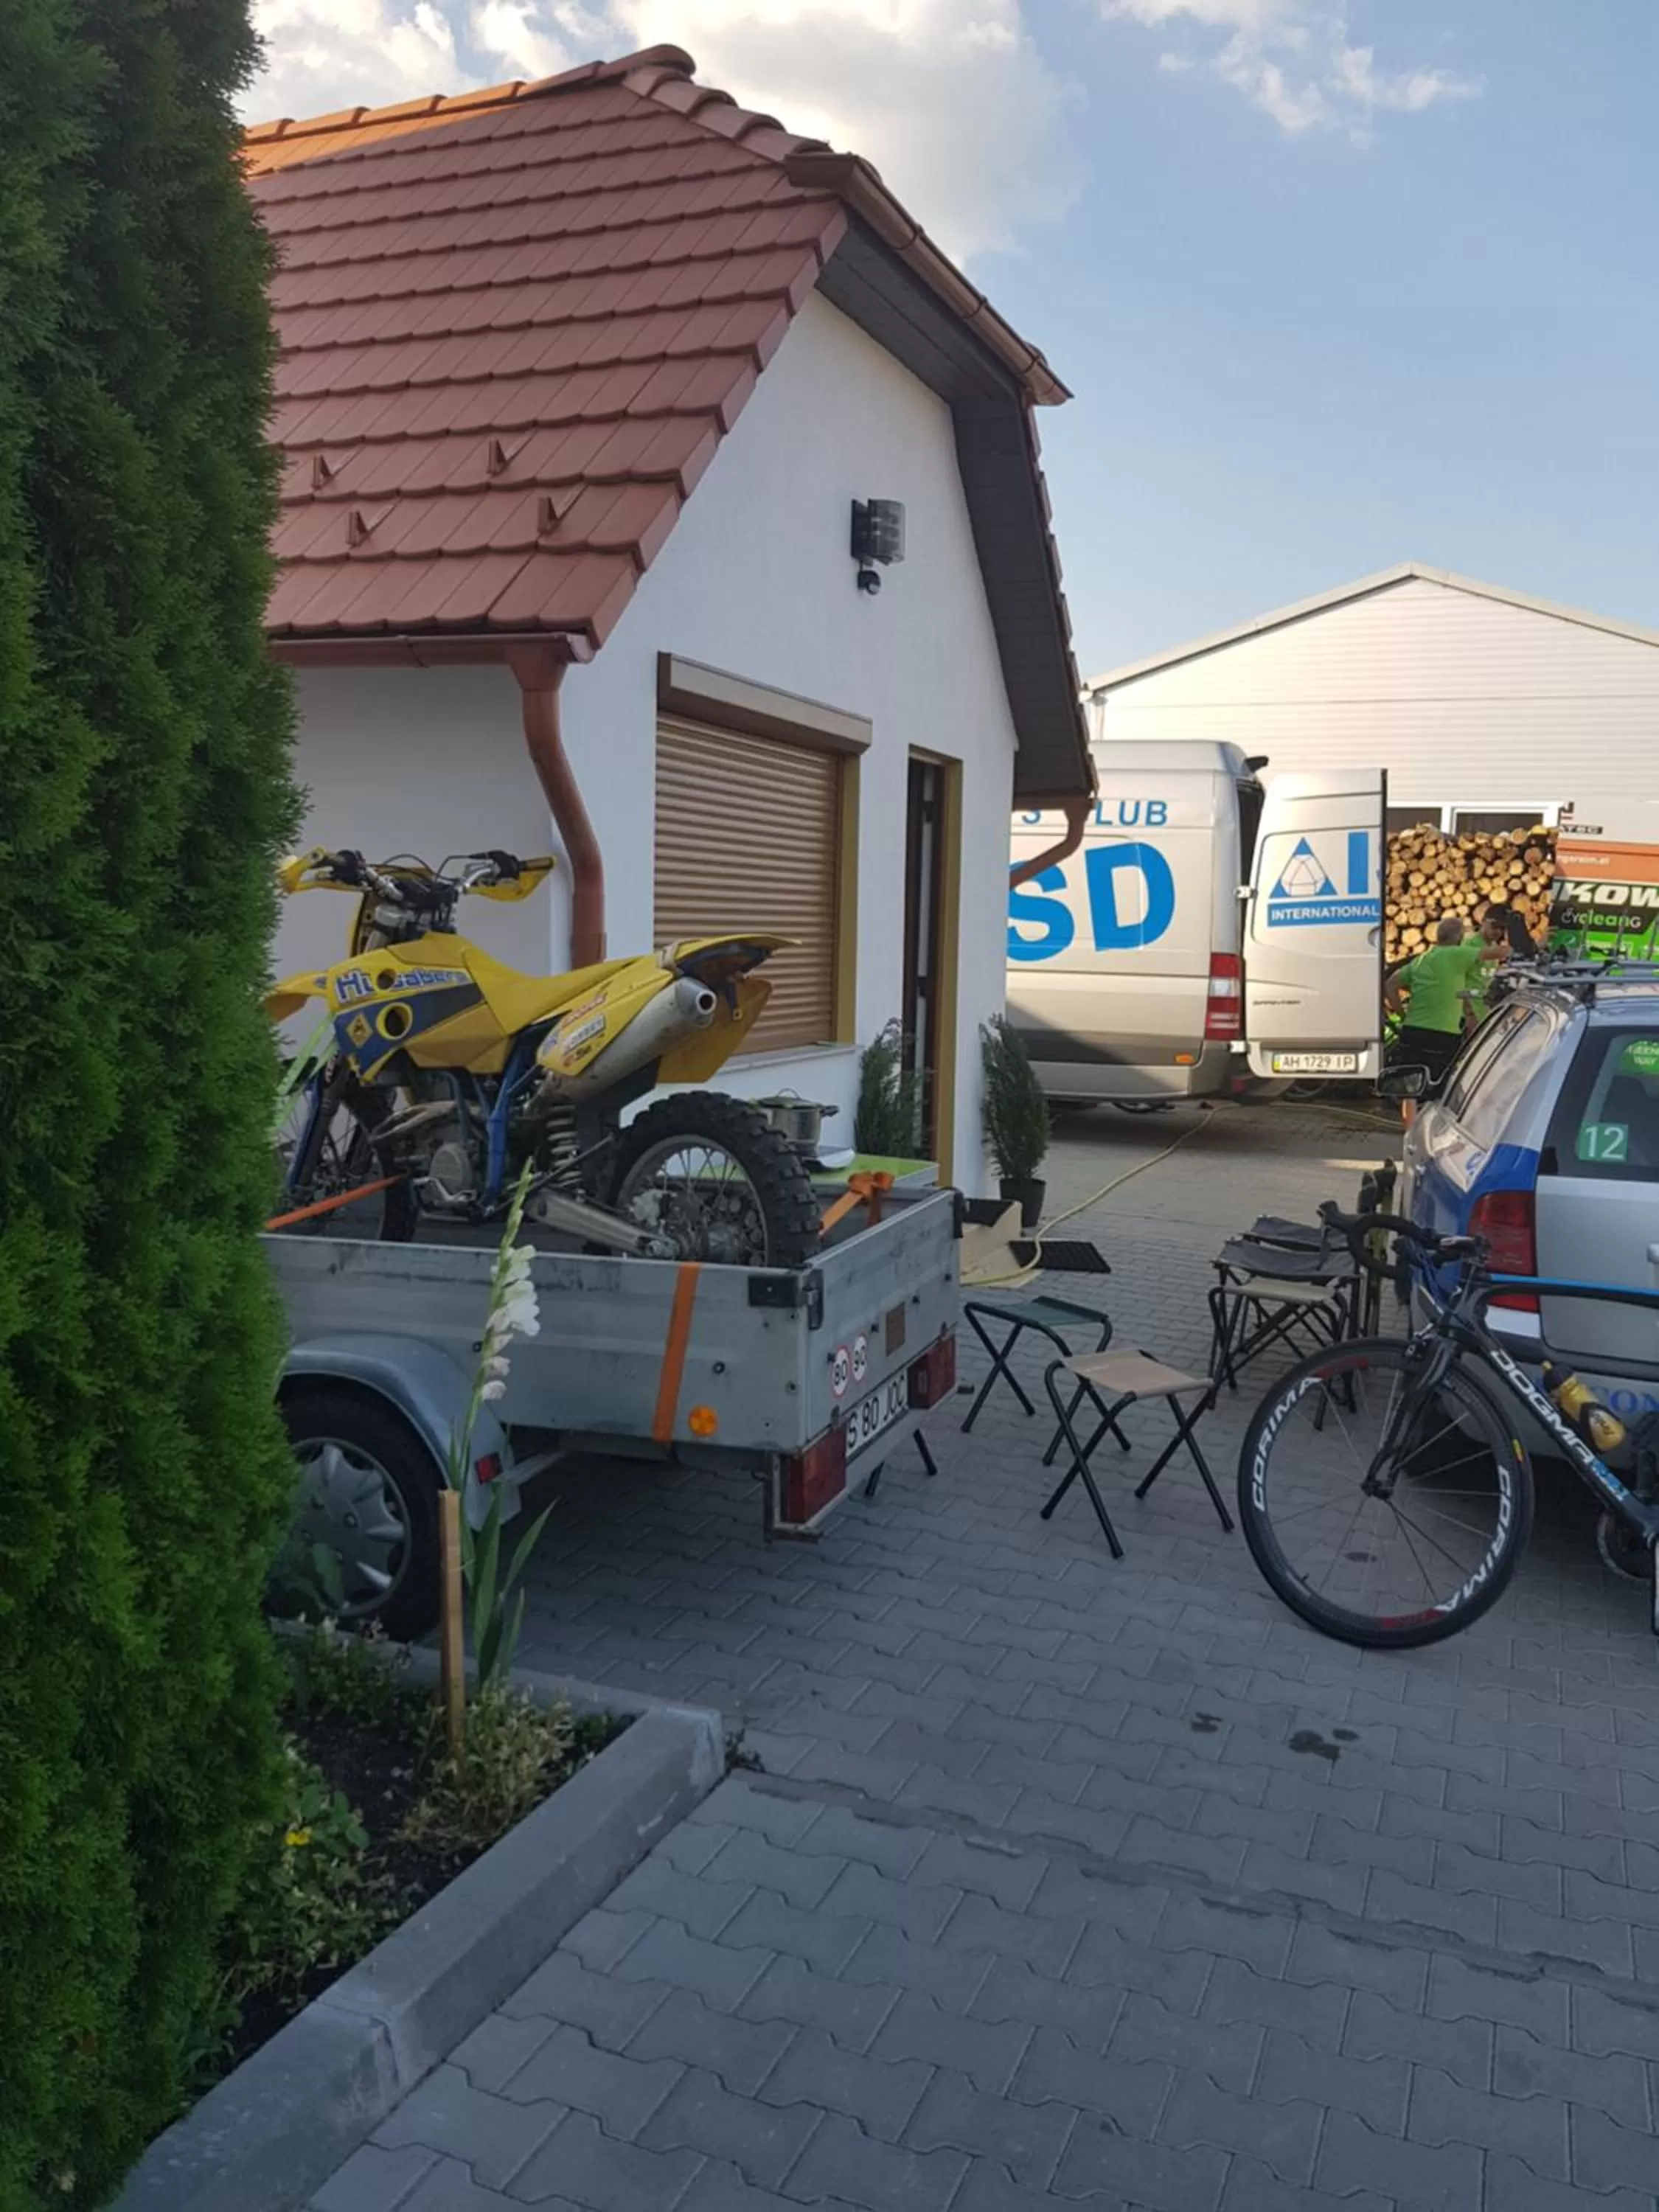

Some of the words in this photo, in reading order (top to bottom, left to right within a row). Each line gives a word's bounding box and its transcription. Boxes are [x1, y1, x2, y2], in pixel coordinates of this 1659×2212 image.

[1094, 801, 1169, 826] LUB
[1271, 905, 1380, 921] INTERNATIONAL
[1283, 1055, 1301, 1068] AH
[1304, 1055, 1332, 1068] 1729
[1585, 1126, 1624, 1159] 12
[862, 1396, 880, 1437] 80
[1489, 1348, 1595, 1464] DOGMA
[1252, 1377, 1323, 1512] CORIMA
[1433, 1464, 1511, 1612] CORIMA
